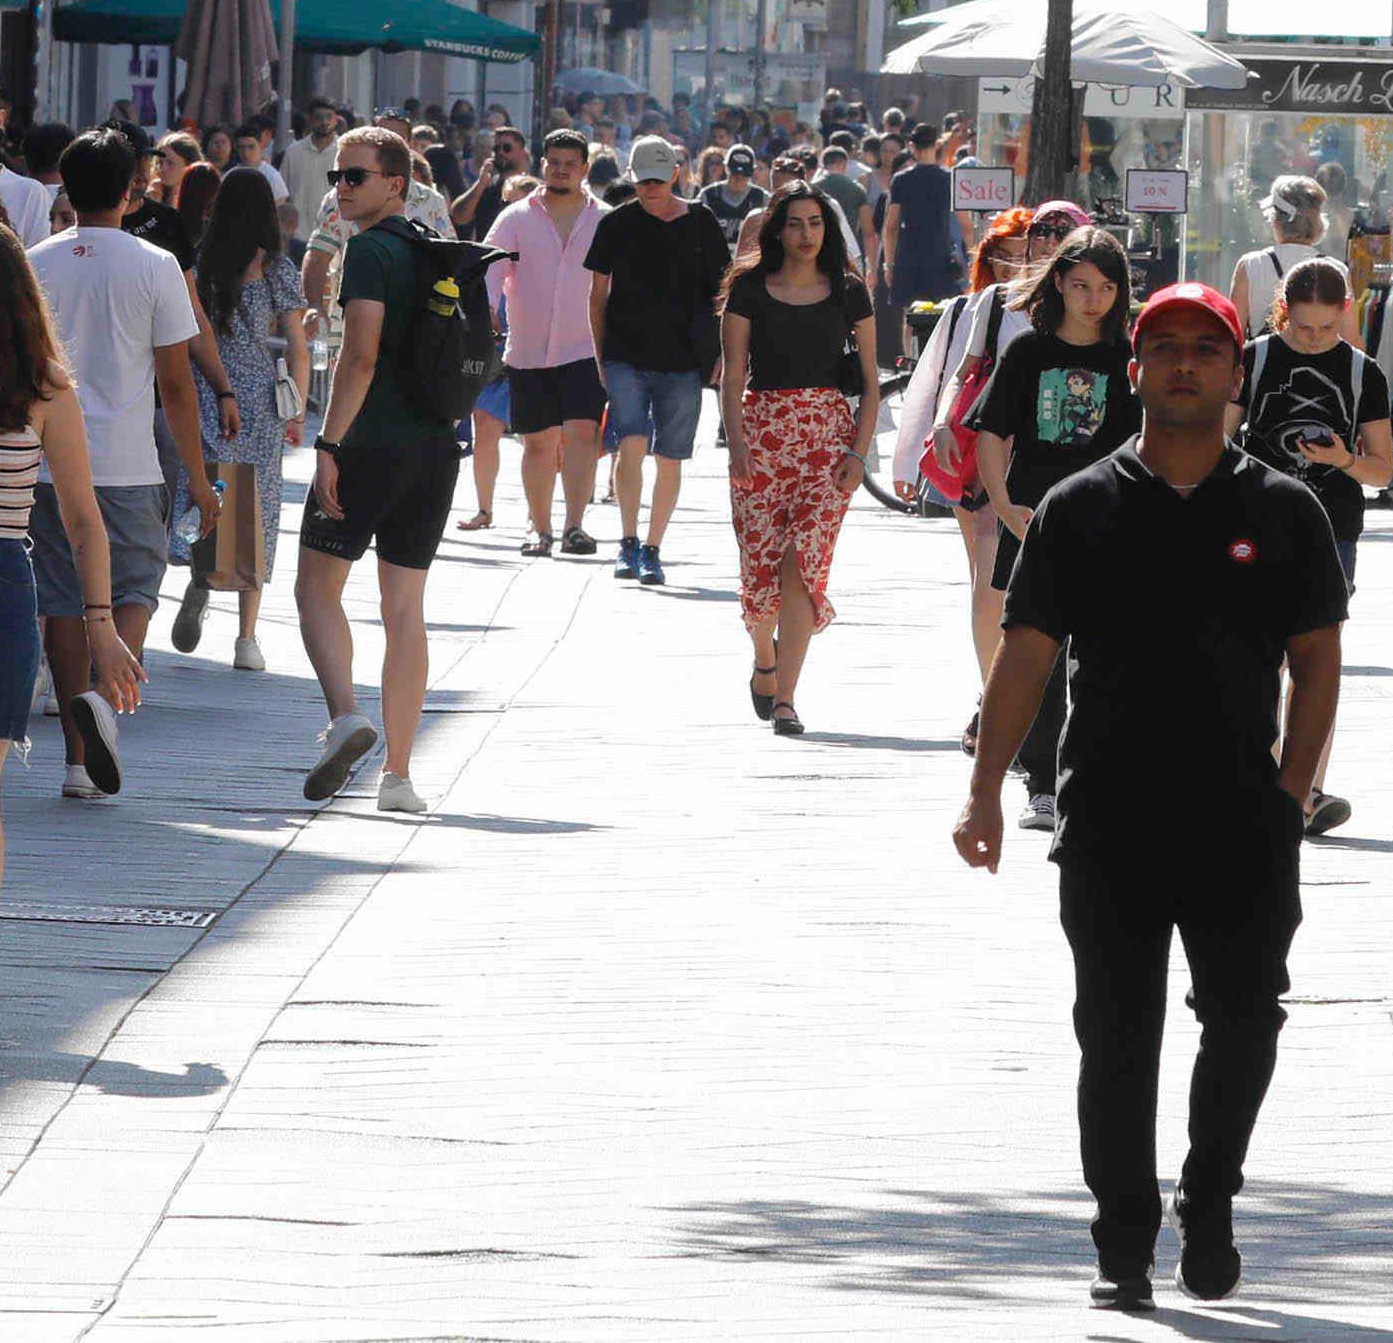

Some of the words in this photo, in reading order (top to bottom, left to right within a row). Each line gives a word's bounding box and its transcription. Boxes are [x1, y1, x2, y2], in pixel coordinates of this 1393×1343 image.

[424, 39, 490, 56] STARBUCKS
[1262, 63, 1362, 103] Nasch
[959, 180, 1007, 201] Sale
